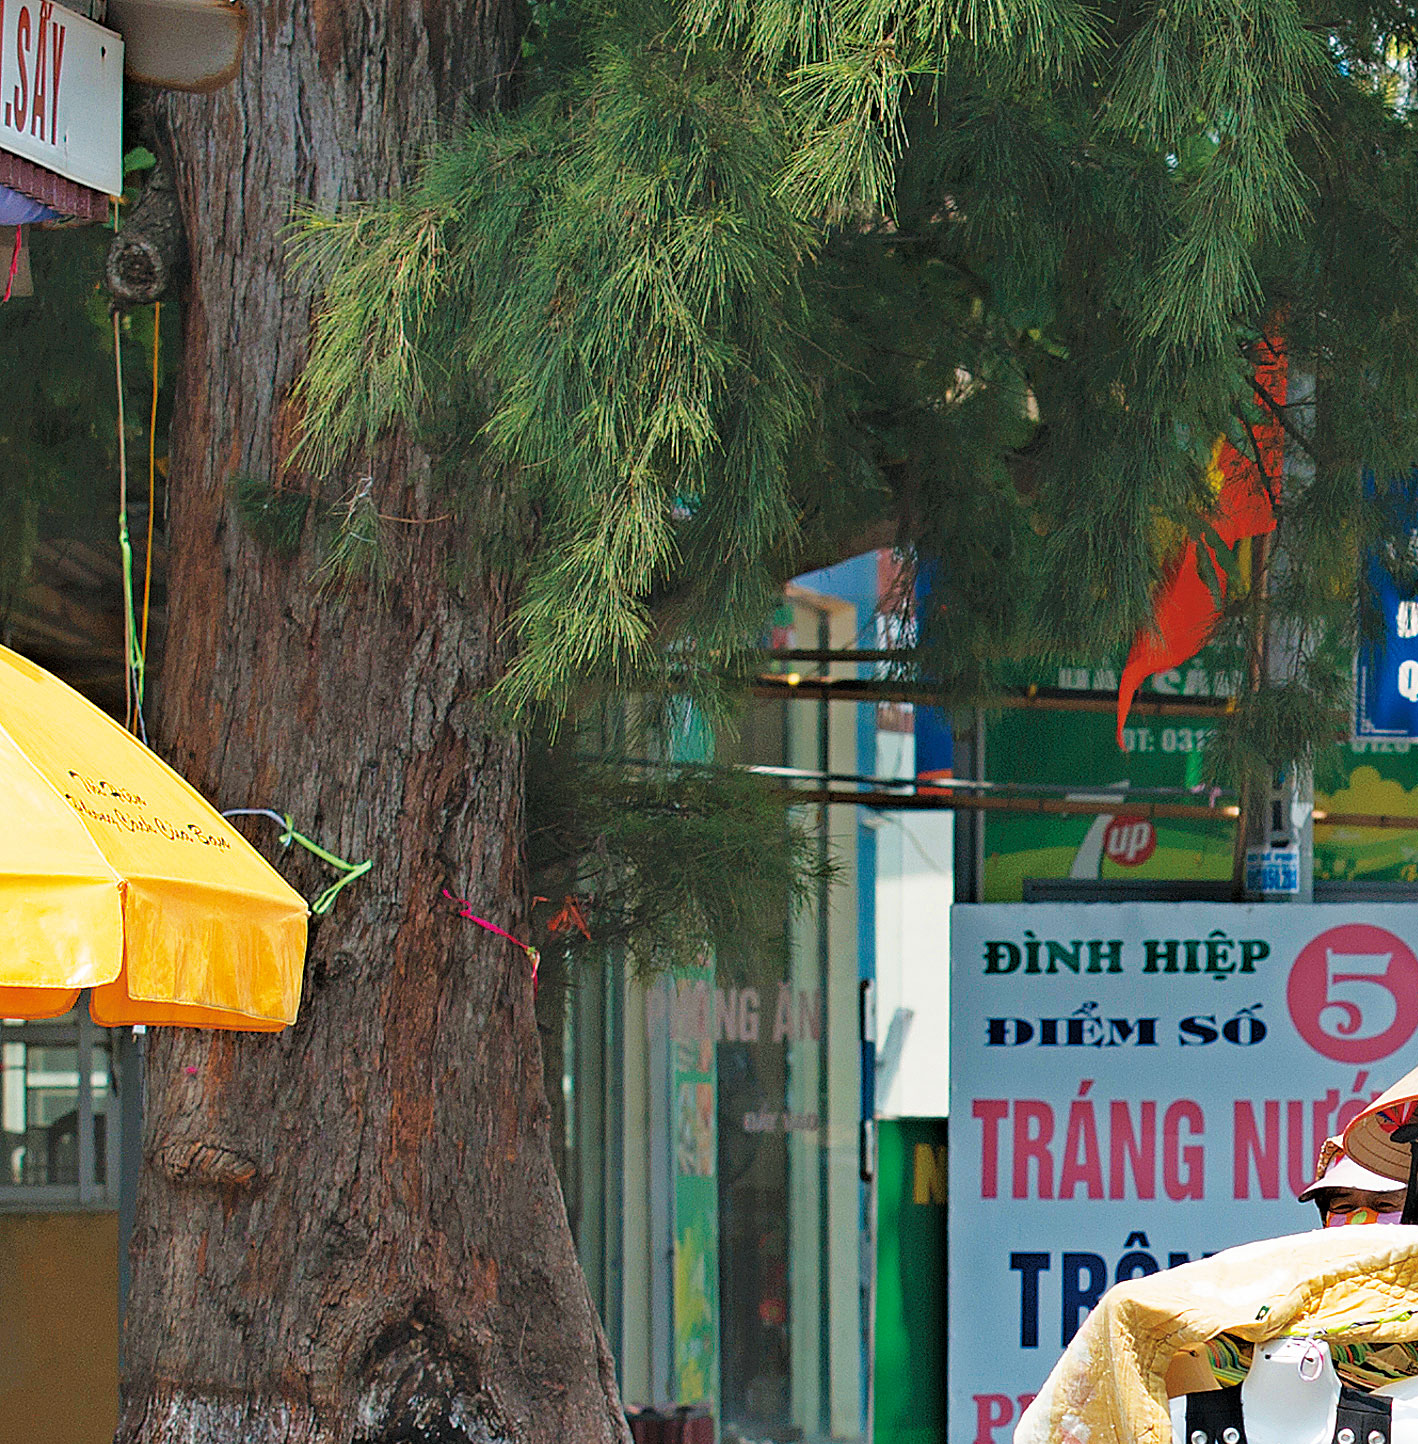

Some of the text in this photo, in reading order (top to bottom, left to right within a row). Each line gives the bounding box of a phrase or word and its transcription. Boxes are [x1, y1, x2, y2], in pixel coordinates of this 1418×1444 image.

[983, 930, 1271, 981] ĐÌNH HIỆP
[984, 1001, 1268, 1047] ĐIỂM SỐ
[1318, 948, 1397, 1040] 5
[973, 1079, 1206, 1201] TRÁNG
